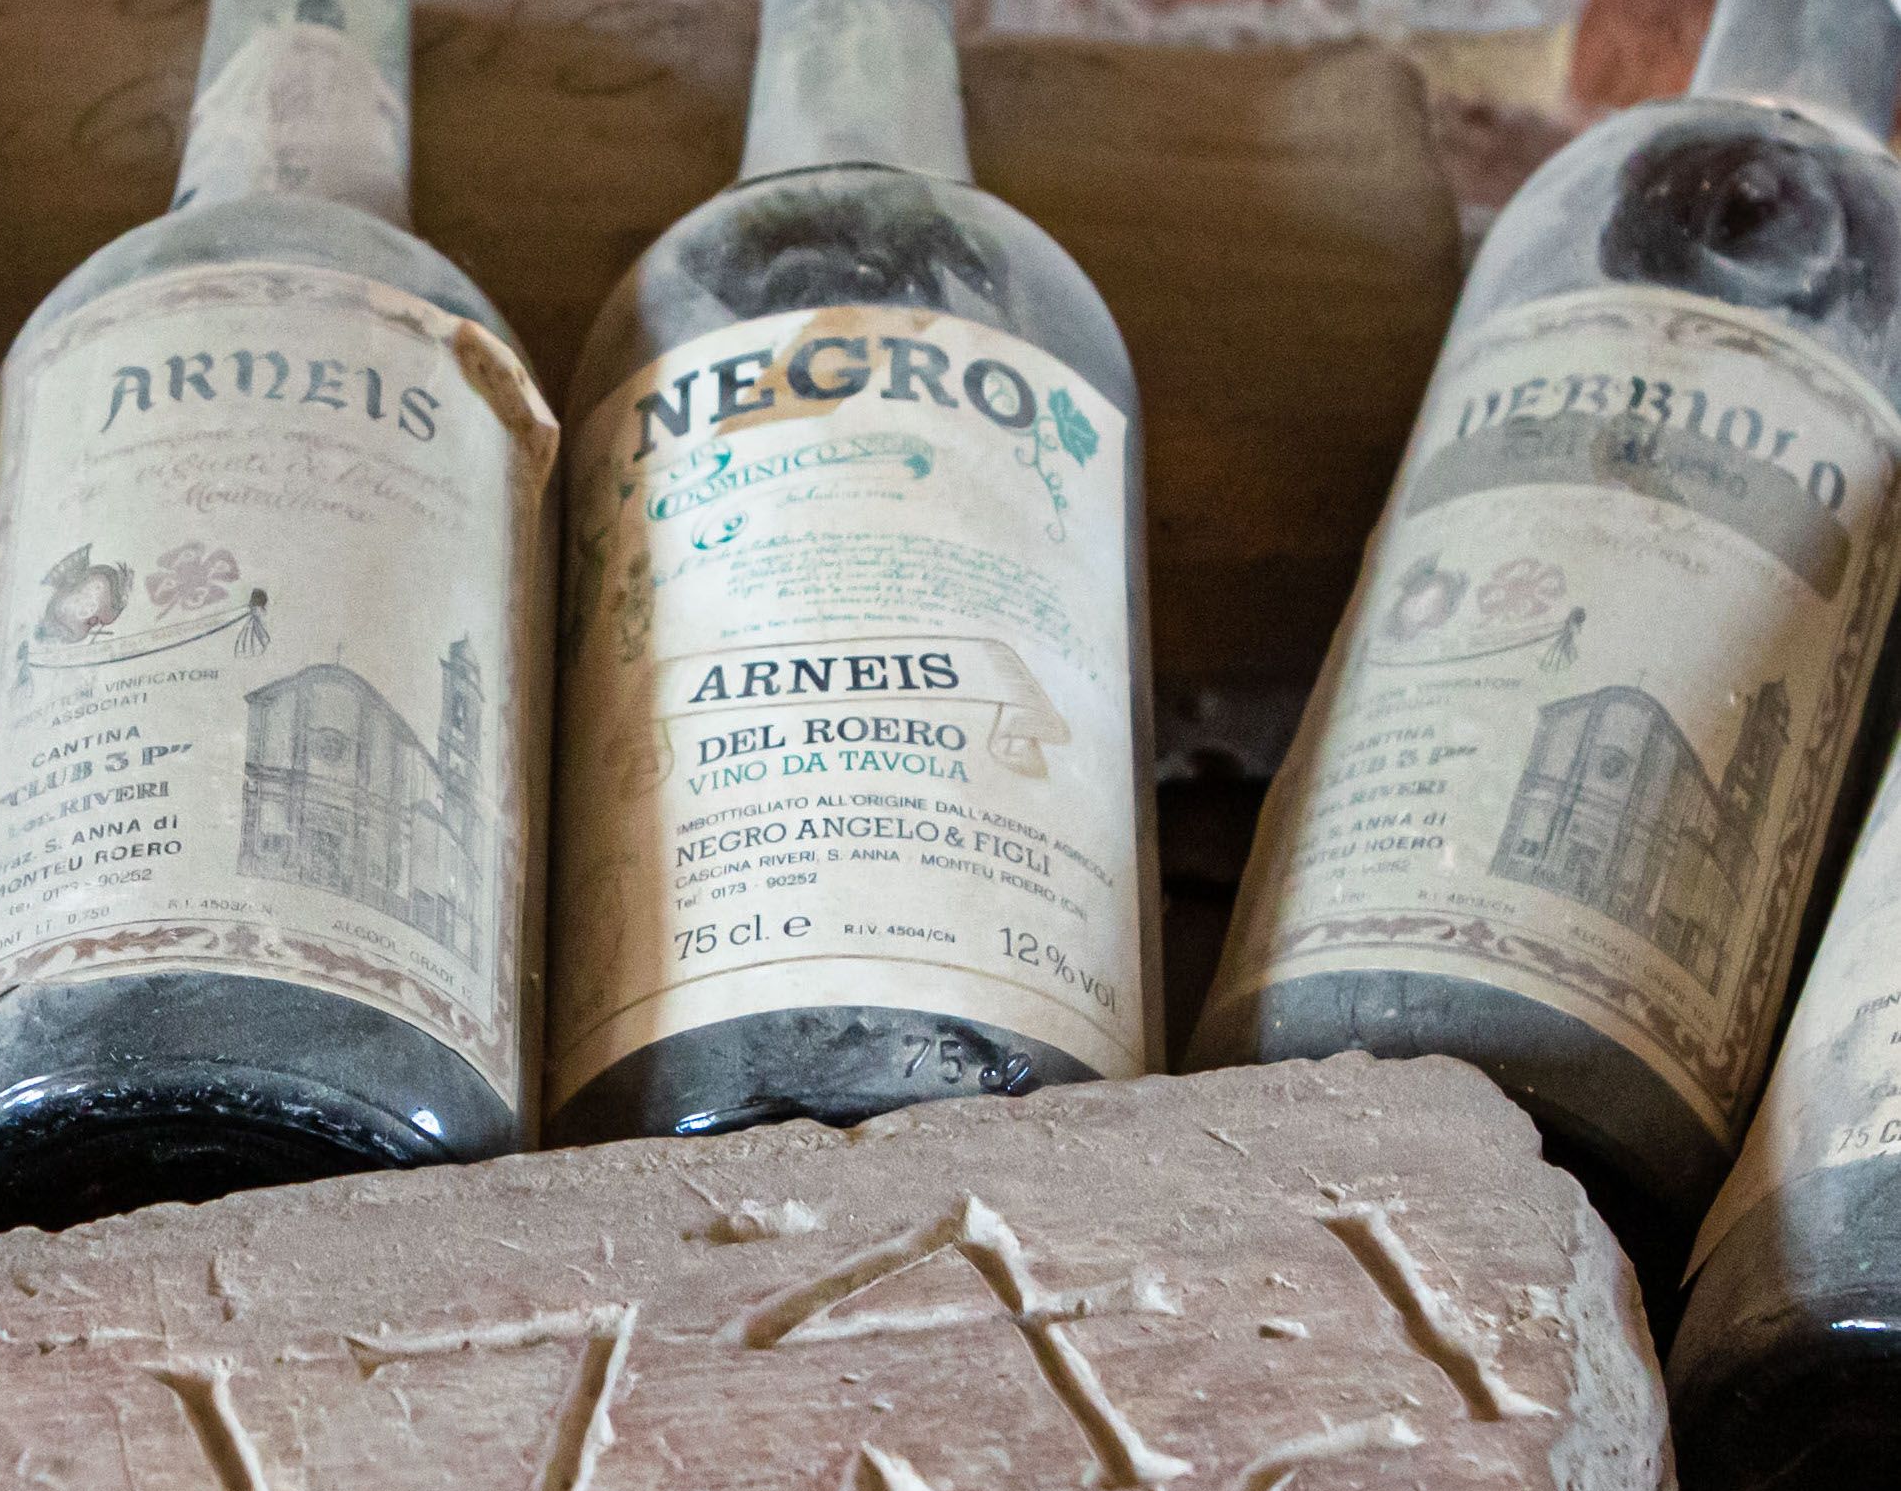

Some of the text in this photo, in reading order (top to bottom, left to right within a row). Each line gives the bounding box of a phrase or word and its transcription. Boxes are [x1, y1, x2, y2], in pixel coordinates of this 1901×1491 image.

[100, 350, 441, 442] ARNEIS
[632, 335, 1040, 462] NEGRO
[104, 668, 220, 694] VINIFICATORI
[688, 652, 961, 704] ARNEIS
[50, 691, 148, 728] ASSOCIATI
[31, 724, 141, 769] CANTINA
[105, 750, 130, 774] 3
[698, 716, 969, 768] DEL ROERO
[688, 749, 971, 797] VINO DA TAVOLA
[59, 780, 170, 819] RIVERI
[675, 796, 810, 836] IMBOTTIGLIATO
[45, 837, 63, 855] S.
[71, 818, 141, 846] ANNA
[153, 814, 179, 831] di
[93, 840, 183, 865] ROERO
[675, 815, 1050, 878] NEGRO ANGELO & FIGLI
[674, 858, 752, 891] CASCINA
[850, 847, 900, 863] ANNA
[921, 853, 994, 879] MONTEU
[1000, 870, 1056, 903] ROERO
[710, 881, 748, 901] 0173
[766, 871, 818, 889] 90252
[330, 920, 399, 952] ALCOOL
[673, 922, 718, 962] 75
[886, 923, 957, 944] 4504/CN
